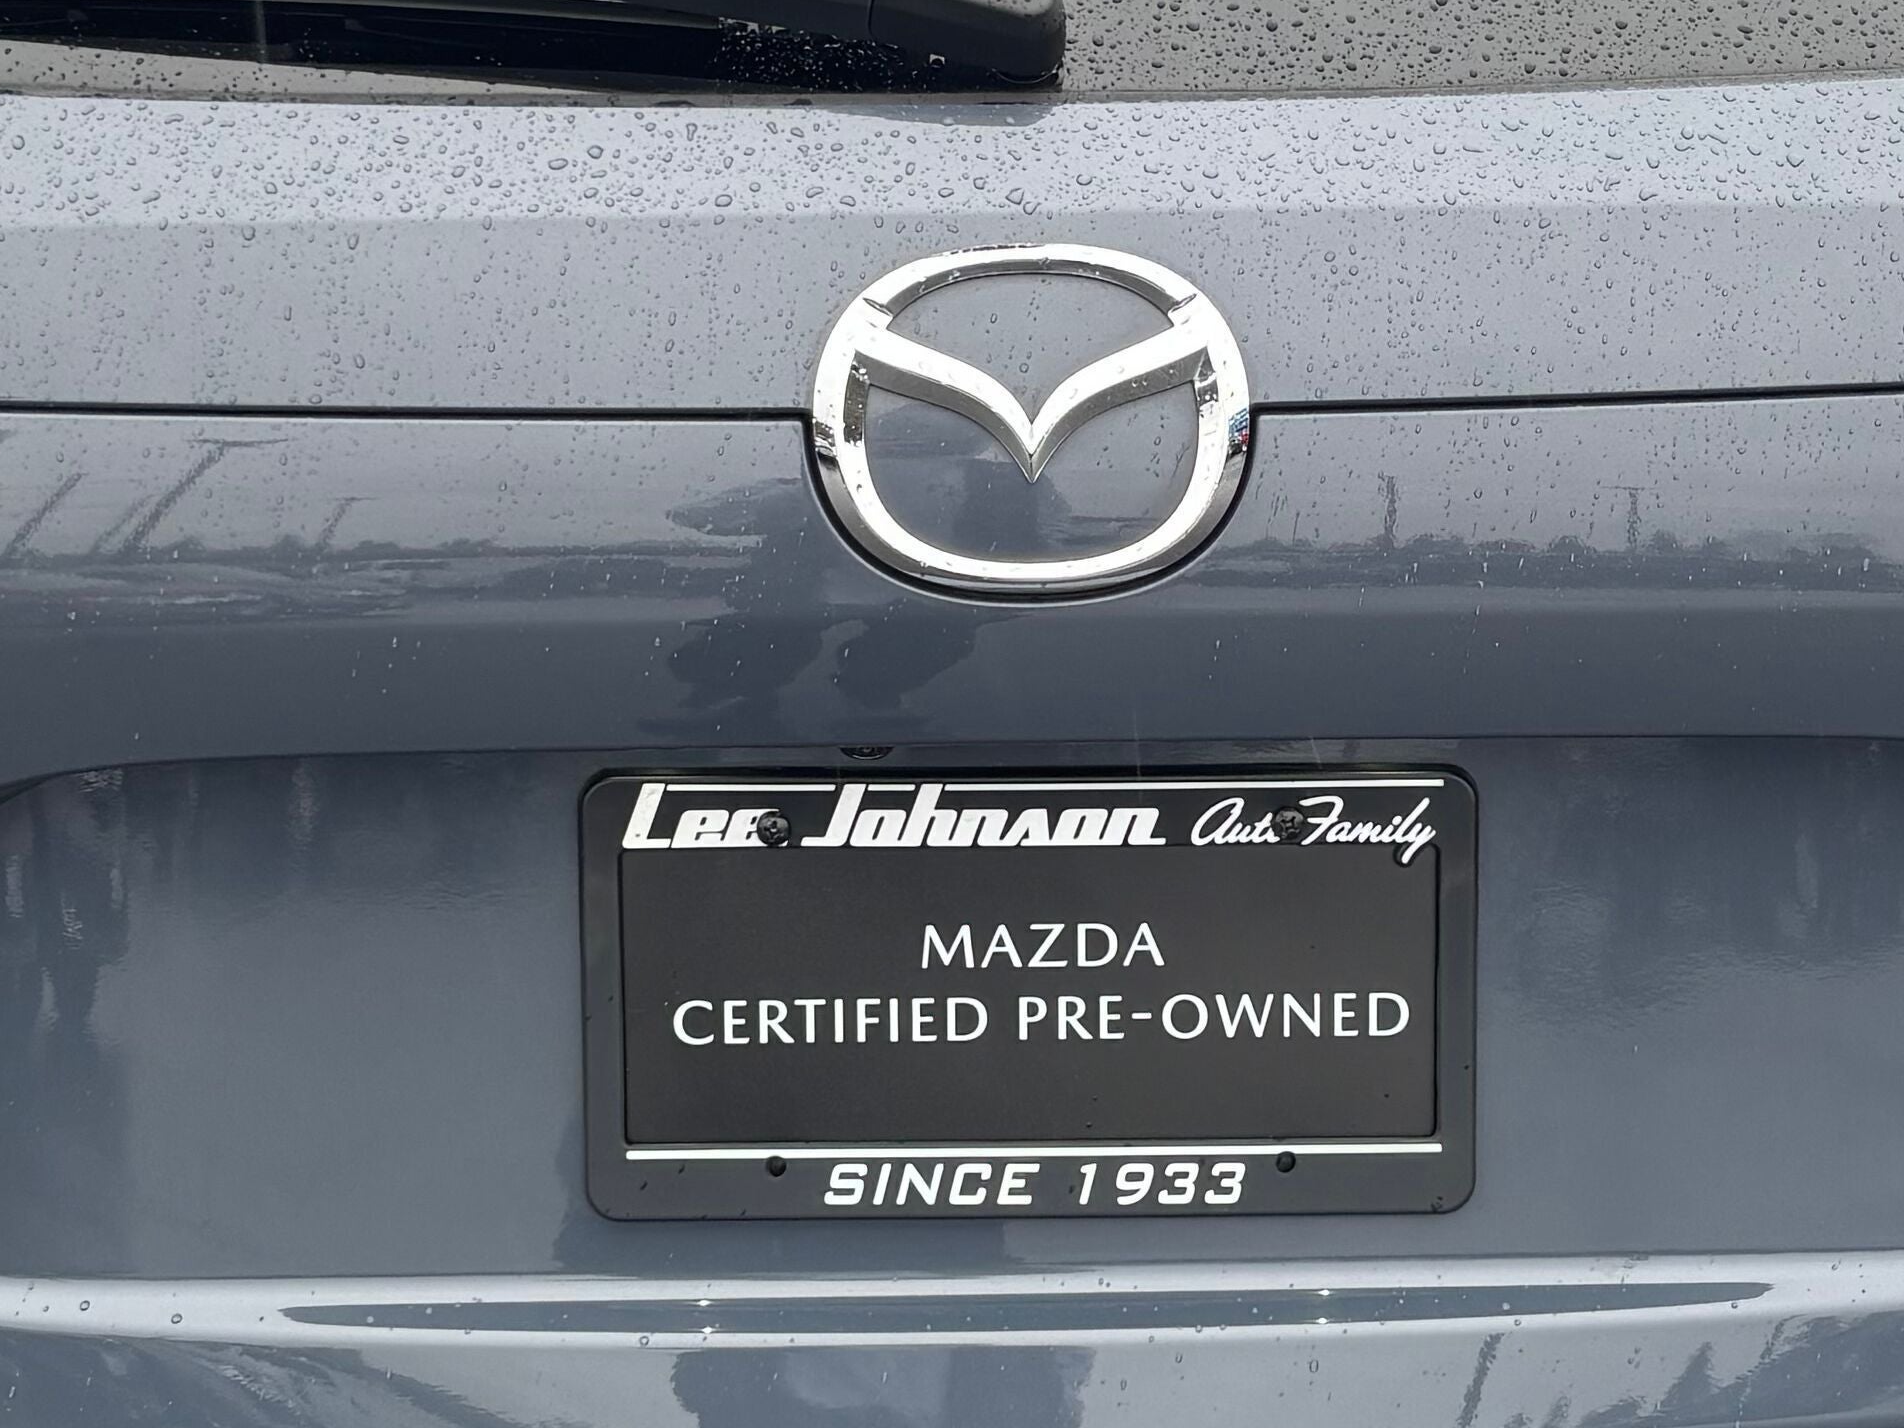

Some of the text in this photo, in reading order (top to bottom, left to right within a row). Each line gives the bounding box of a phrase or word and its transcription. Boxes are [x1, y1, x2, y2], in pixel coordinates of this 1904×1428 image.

[621, 782, 1437, 864] Lee Johnson Aut Family
[921, 922, 1165, 969] MAZDA
[673, 992, 1410, 1046] CERTIFIED PRE-OWNED
[823, 1162, 1246, 1206] SINCE 1933
